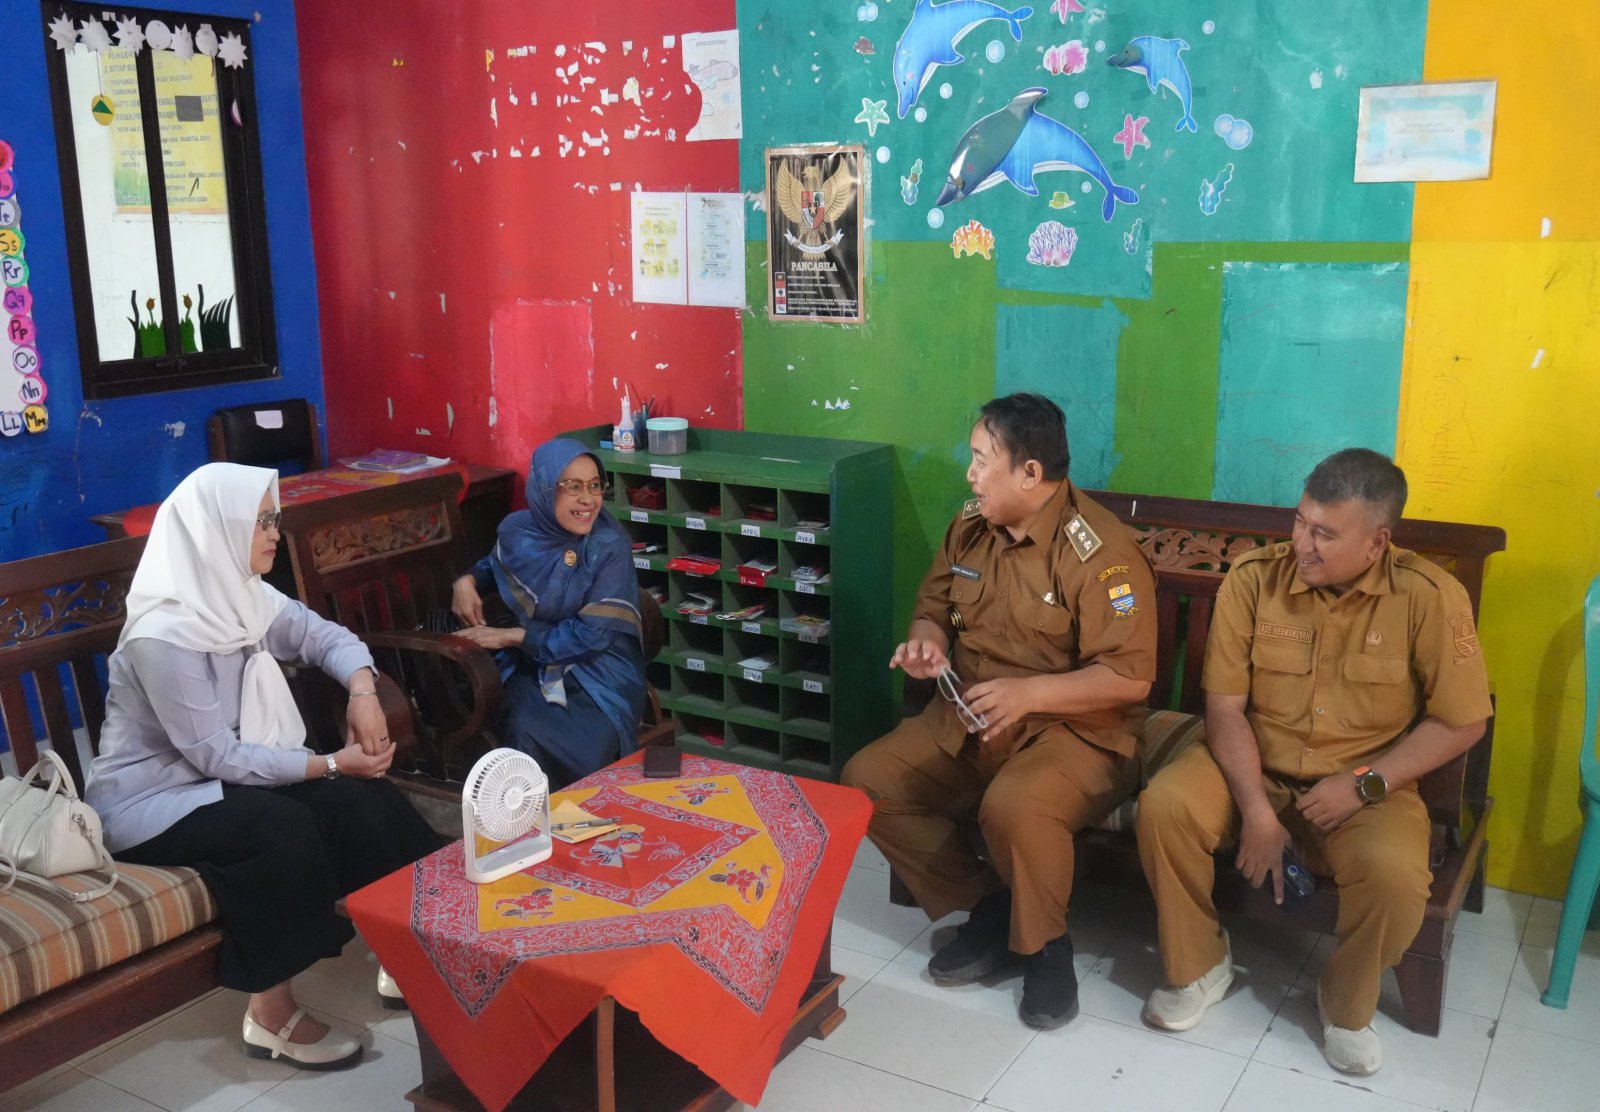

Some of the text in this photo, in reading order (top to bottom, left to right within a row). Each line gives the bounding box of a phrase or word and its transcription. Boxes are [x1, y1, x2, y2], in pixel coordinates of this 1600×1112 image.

[3, 261, 21, 280] Rr
[791, 261, 838, 272] PANCASILA
[11, 319, 28, 340] Pp
[22, 381, 40, 399] Nn
[1260, 623, 1273, 635] ADE
